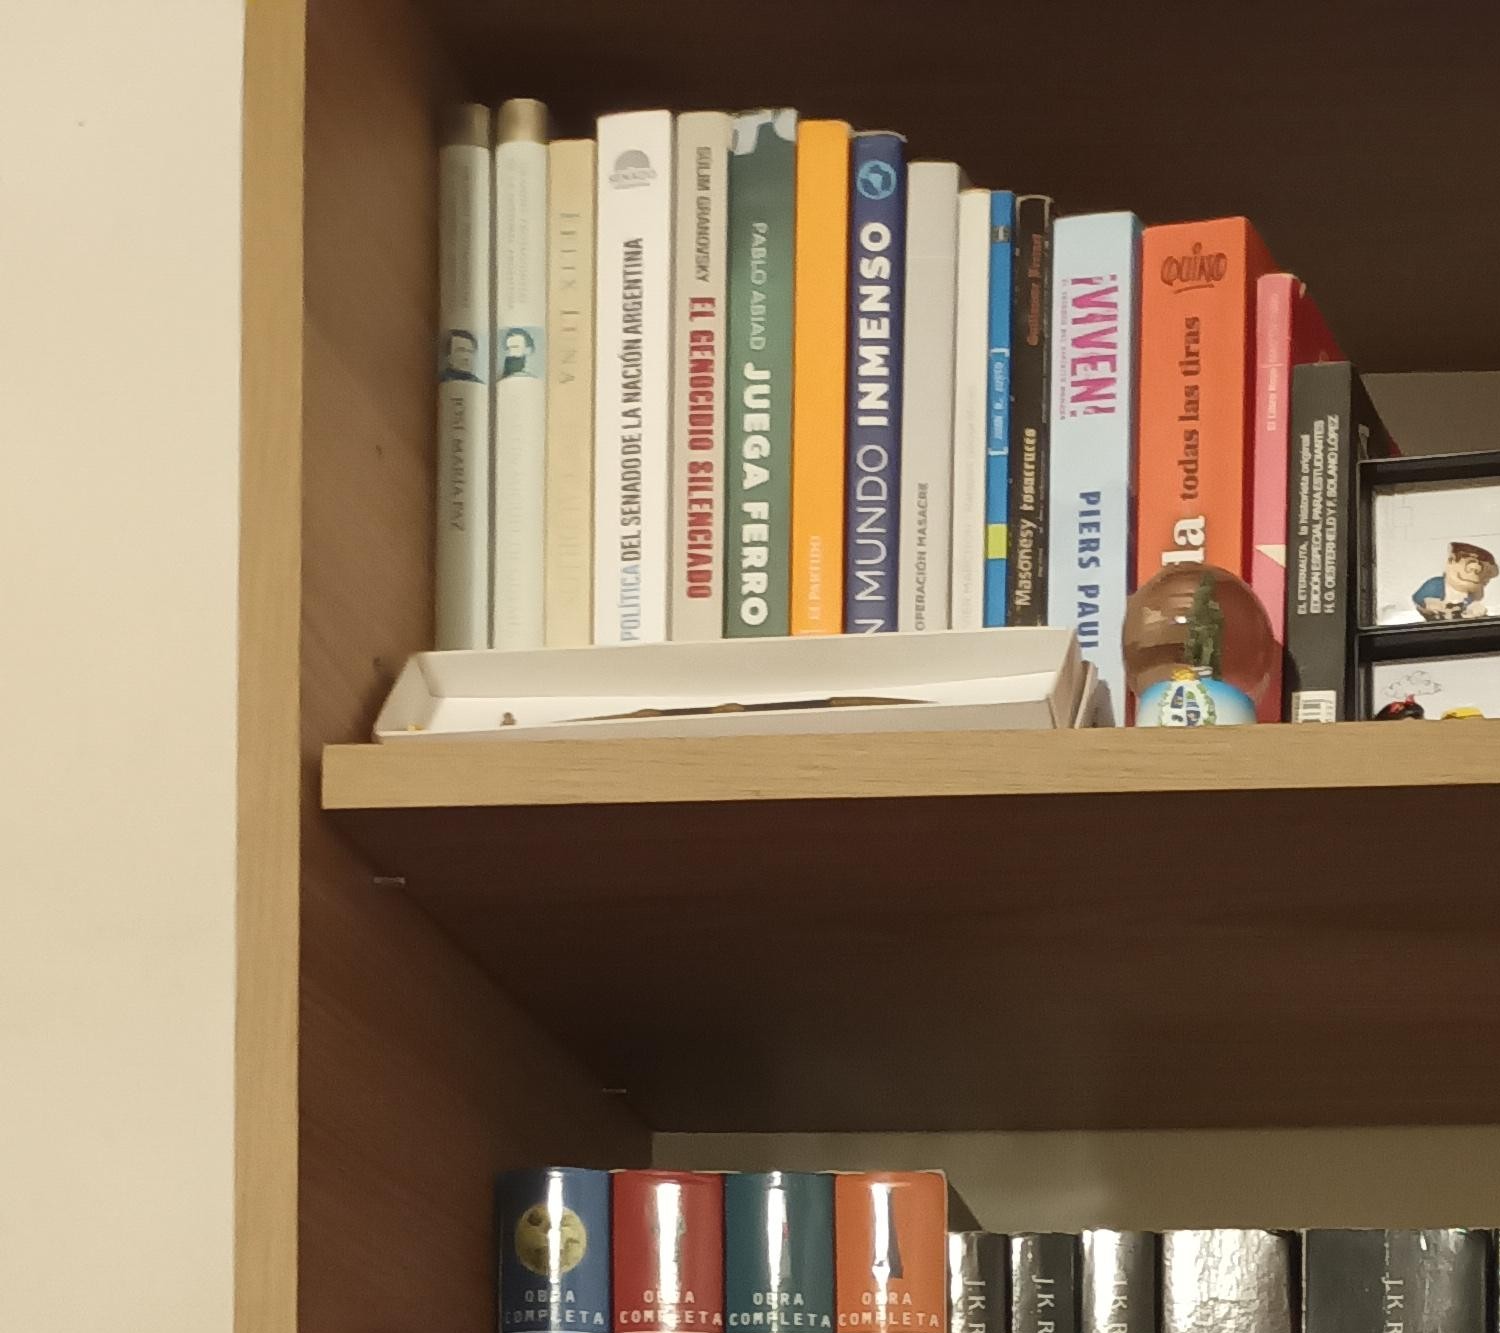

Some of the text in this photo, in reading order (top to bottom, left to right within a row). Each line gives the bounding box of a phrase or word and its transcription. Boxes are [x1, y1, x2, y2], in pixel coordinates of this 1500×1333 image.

[854, 222, 893, 602] MUNDO INMENSO
[1069, 273, 1118, 418] ¡VIVEN!
[1178, 314, 1200, 376] tiras
[1179, 379, 1200, 422] las
[617, 238, 643, 641] POLÍTICA DEL SENADO DE LA NACIÓN ARGENTINA
[686, 297, 714, 599] EL GENOCIDIO SILENCIADO
[740, 362, 770, 627] JUEGA FERRO
[1179, 428, 1200, 501] todas
[1077, 490, 1101, 570] PIERS
